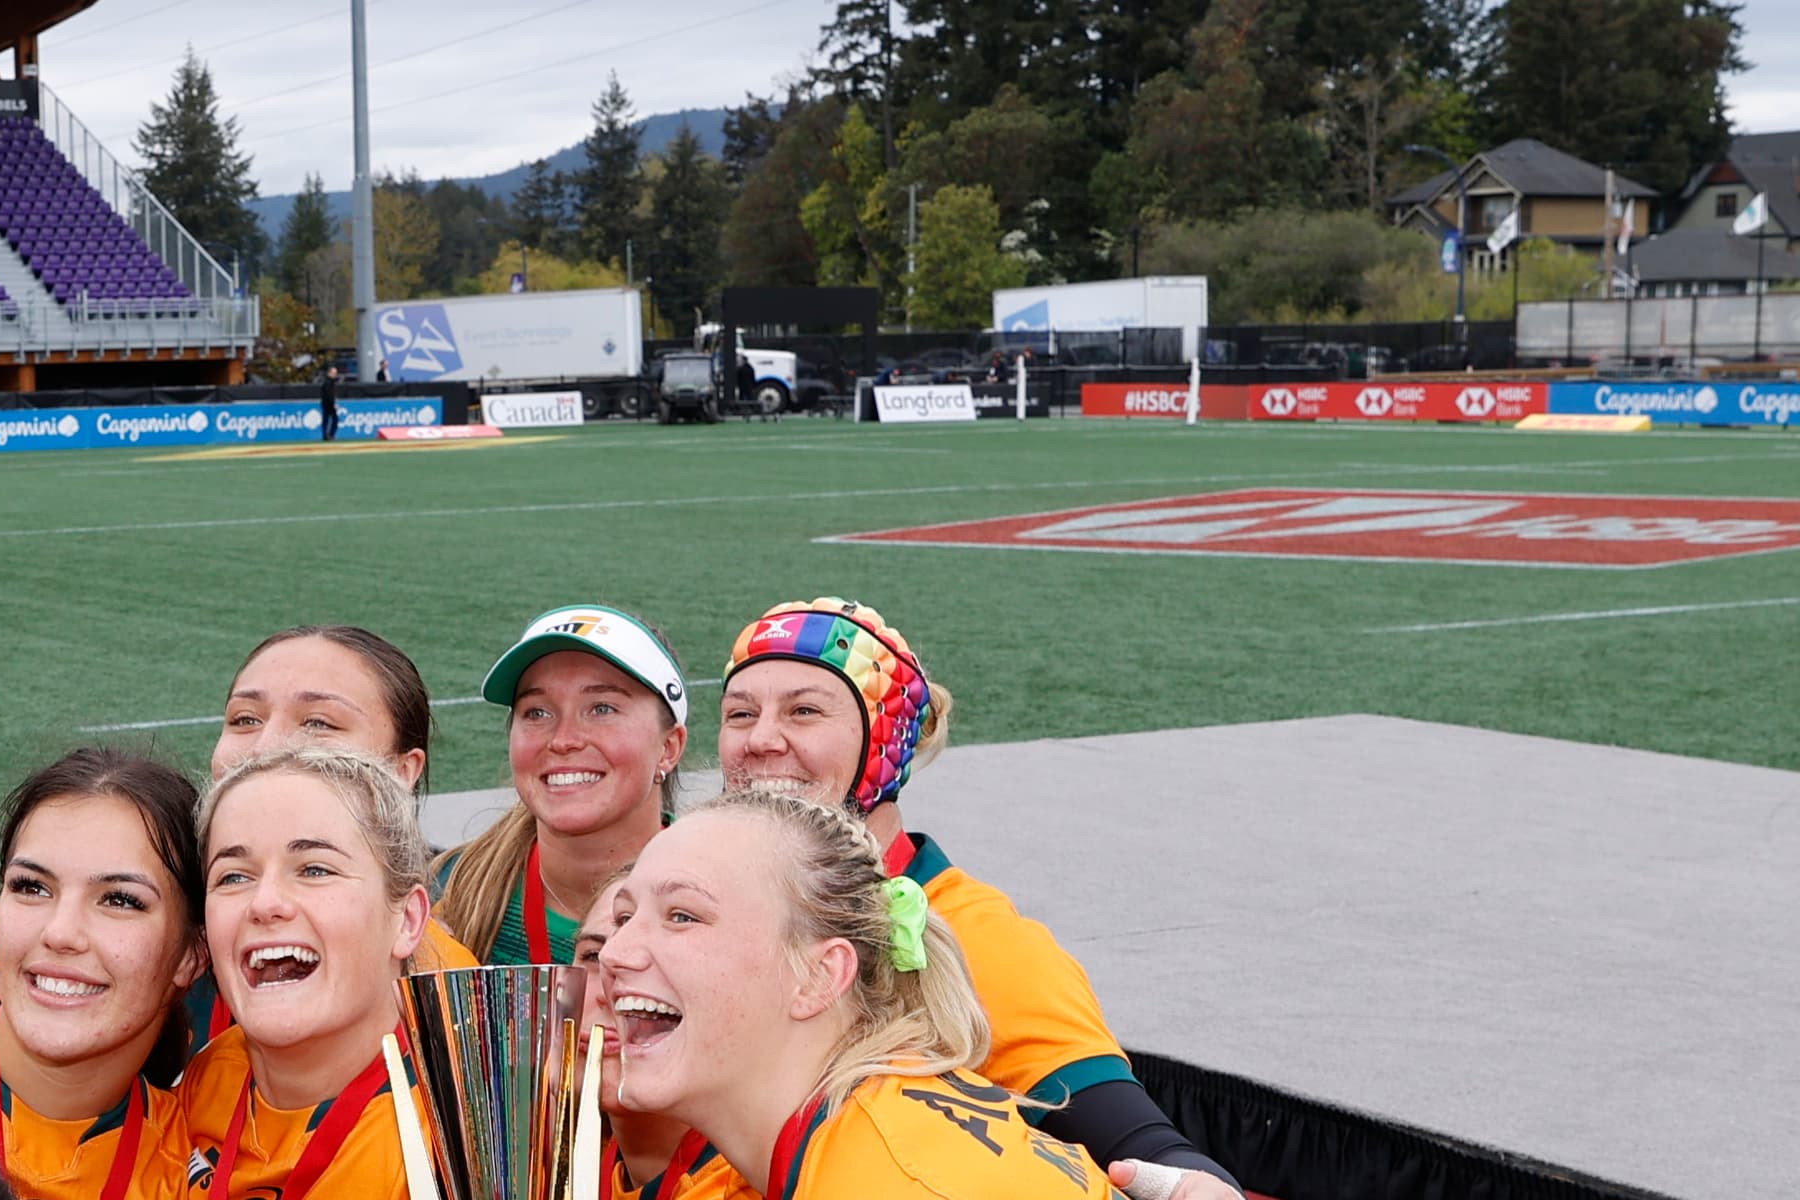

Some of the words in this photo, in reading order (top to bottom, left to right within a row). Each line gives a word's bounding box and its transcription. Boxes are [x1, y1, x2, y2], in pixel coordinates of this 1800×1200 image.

[488, 397, 576, 425] Canada
[881, 388, 968, 416] Langford
[1125, 390, 1200, 412] #HSBC7
[1595, 386, 1694, 416] Capgemini
[97, 412, 188, 442] Capgemini
[216, 410, 303, 438] Capgemini
